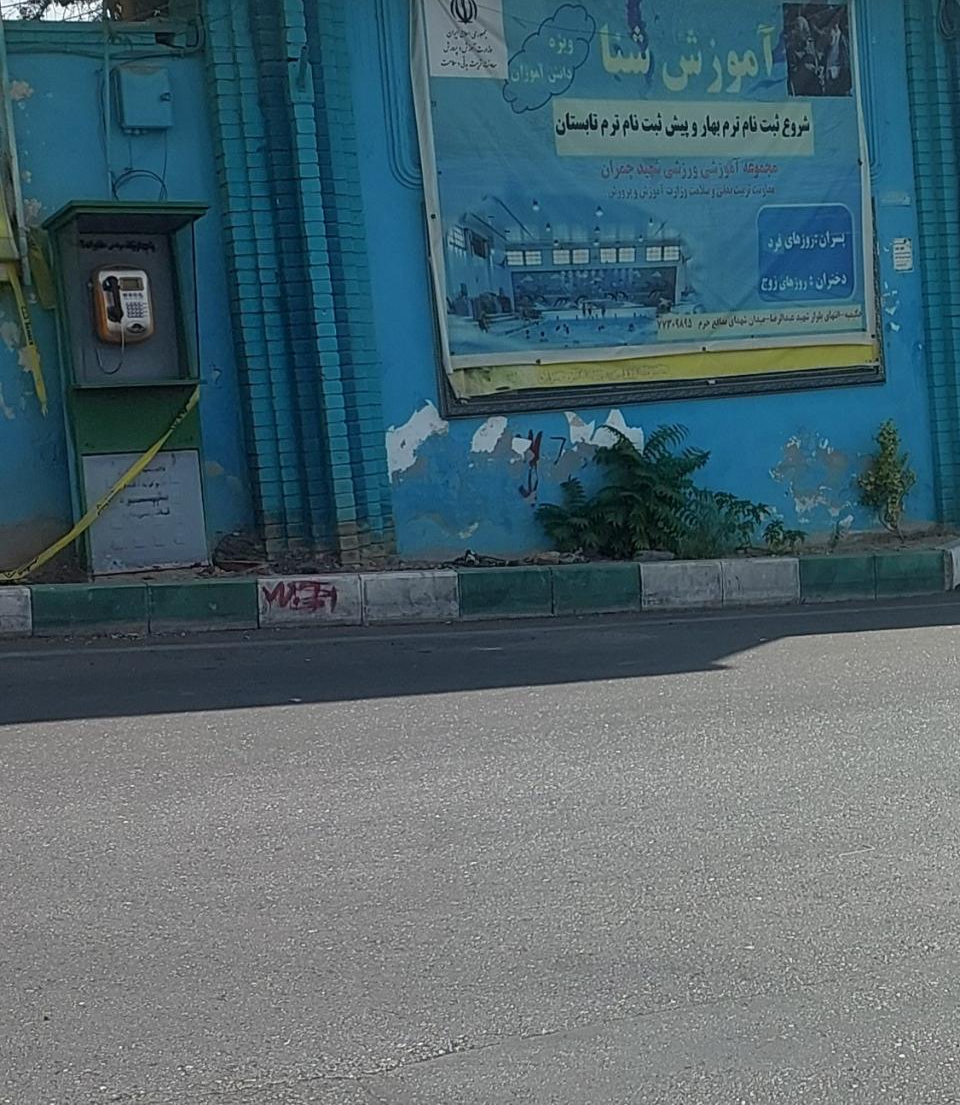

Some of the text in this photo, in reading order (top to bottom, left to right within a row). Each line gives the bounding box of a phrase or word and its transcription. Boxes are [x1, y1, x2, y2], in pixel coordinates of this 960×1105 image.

[549, 36, 574, 55] ویژه
[600, 22, 776, 94] آموزش شنا
[547, 65, 573, 84] دانش
[556, 112, 811, 138] شروع ثبت نام ترم بهار و پیش ثبت نام ترم تابستان
[600, 158, 777, 180] مجموعه آموزشی ورزشی شهید چمران
[767, 233, 783, 253] فرد
[761, 276, 778, 291] زوج
[779, 275, 808, 291] روزهای
[815, 271, 847, 291] دختران
